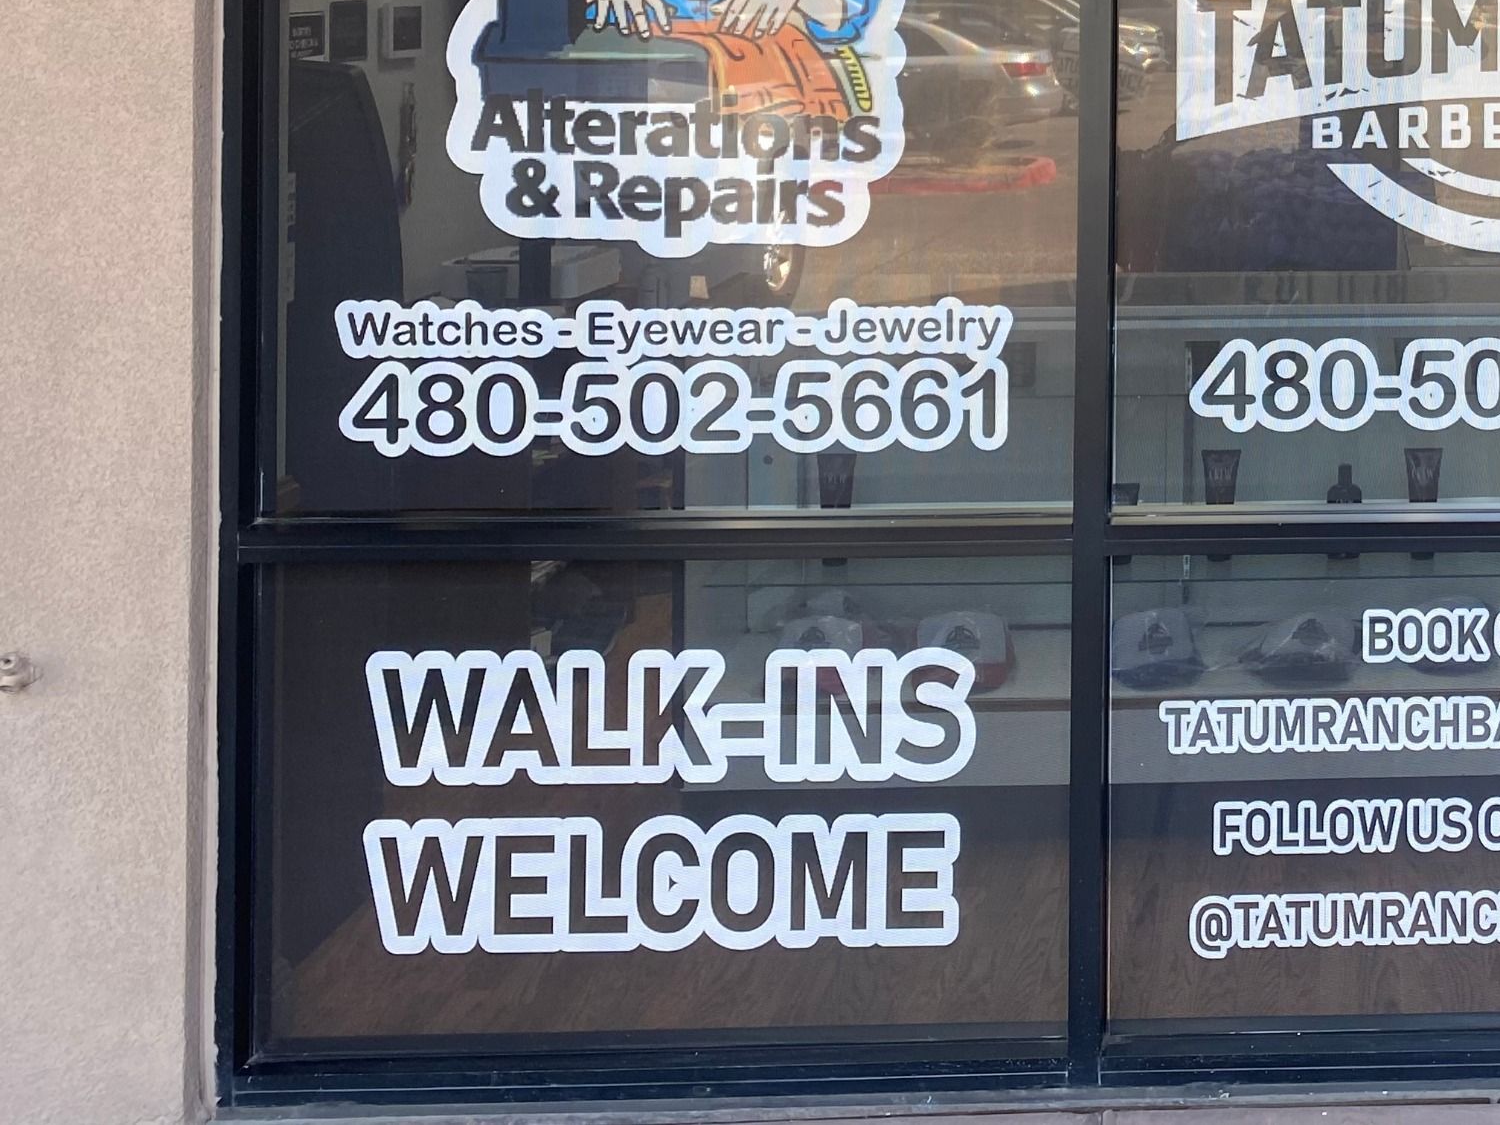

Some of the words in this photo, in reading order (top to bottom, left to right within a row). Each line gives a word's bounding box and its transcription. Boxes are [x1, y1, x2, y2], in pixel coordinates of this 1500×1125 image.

[470, 87, 883, 163] Alterations
[505, 157, 561, 218] &
[573, 160, 848, 239] Repairs
[344, 308, 548, 349] Watches
[585, 308, 787, 357] Eyewear
[821, 305, 1004, 356] Jewelry
[347, 367, 1002, 449] 480-502-5661
[1365, 610, 1489, 661] BOOK
[374, 656, 969, 776] WALK-INS
[1216, 801, 1401, 852] FOLLOW
[1408, 799, 1470, 850] US
[372, 822, 953, 946] WELCOME
